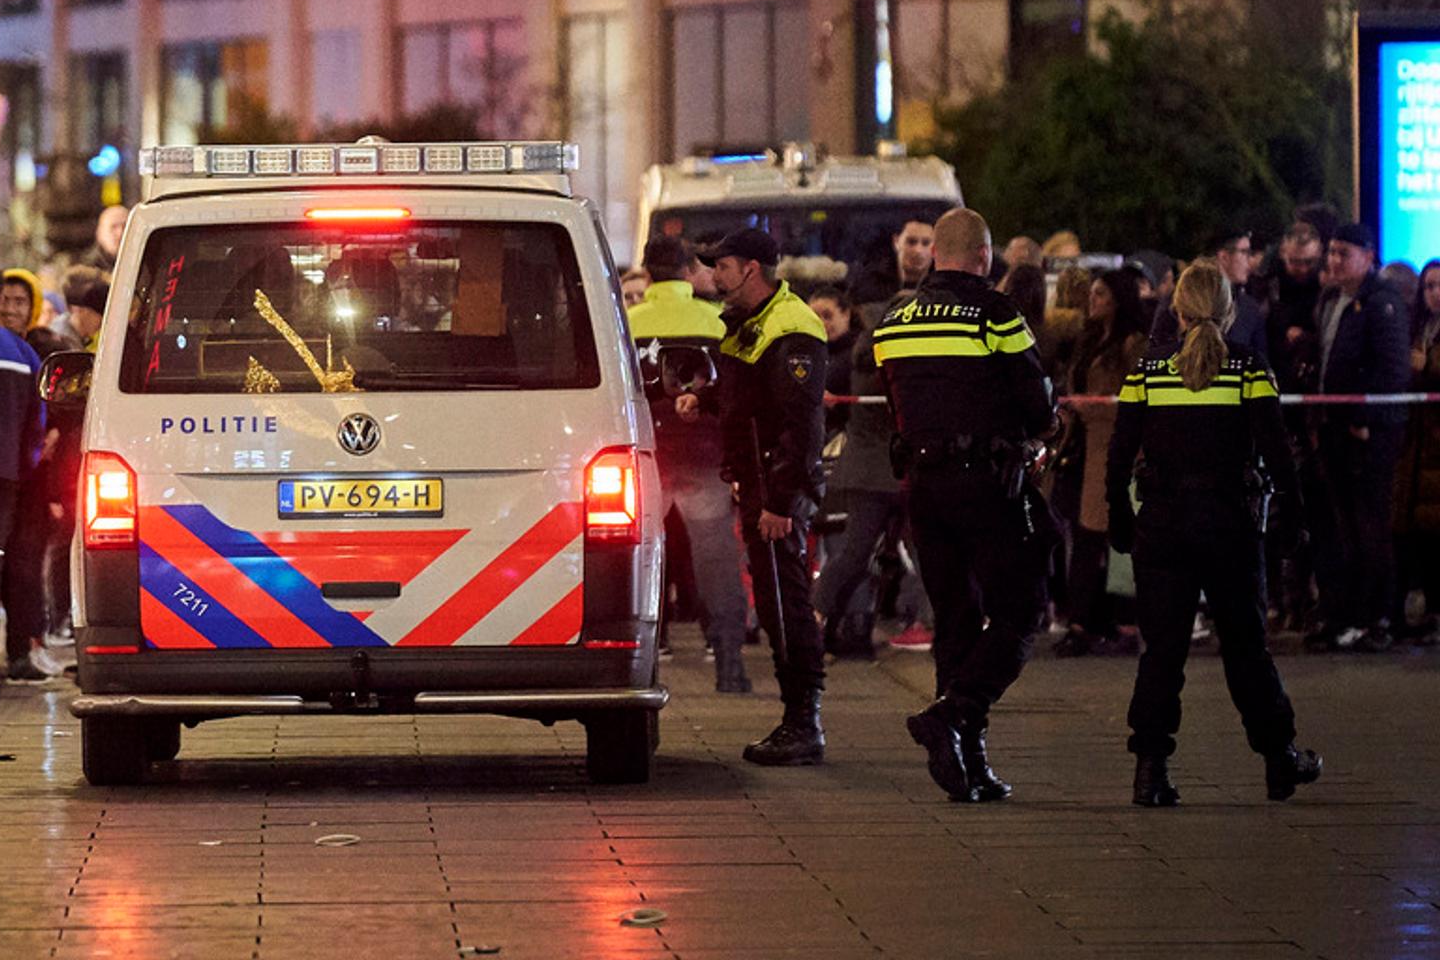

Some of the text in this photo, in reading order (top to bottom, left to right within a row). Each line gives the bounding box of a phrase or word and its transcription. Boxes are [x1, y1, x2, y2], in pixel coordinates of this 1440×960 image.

[894, 298, 962, 323] POLITIE
[161, 415, 278, 435] POLITIE
[301, 484, 430, 508] PV-694-H
[173, 583, 209, 616] 7211
